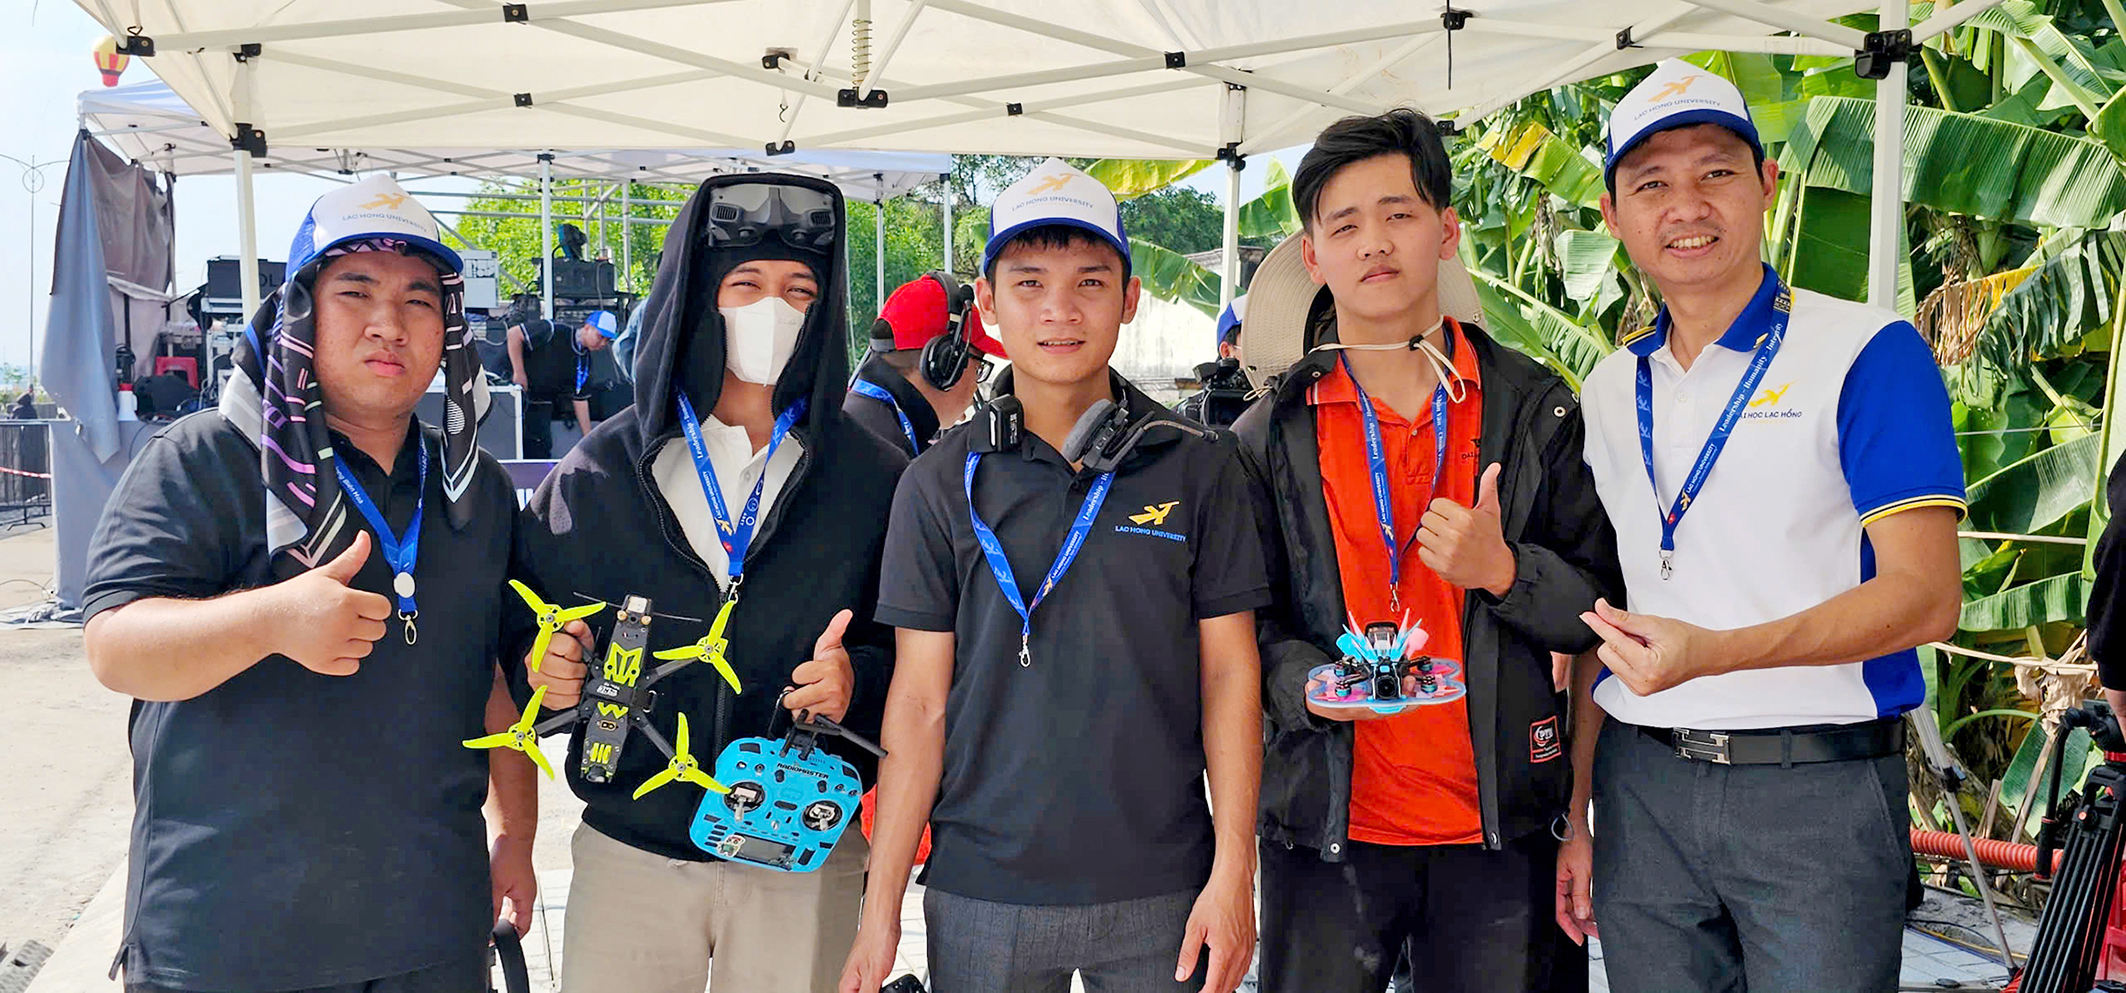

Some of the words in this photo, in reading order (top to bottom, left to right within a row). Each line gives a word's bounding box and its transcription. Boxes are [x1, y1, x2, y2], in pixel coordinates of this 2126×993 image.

[1719, 394, 1745, 432] Leadership
[1083, 485, 1104, 520] Leadership
[1130, 527, 1151, 535] HONG
[1152, 530, 1186, 541] UNIVERSITY
[777, 762, 829, 779] RADIOMASTER
